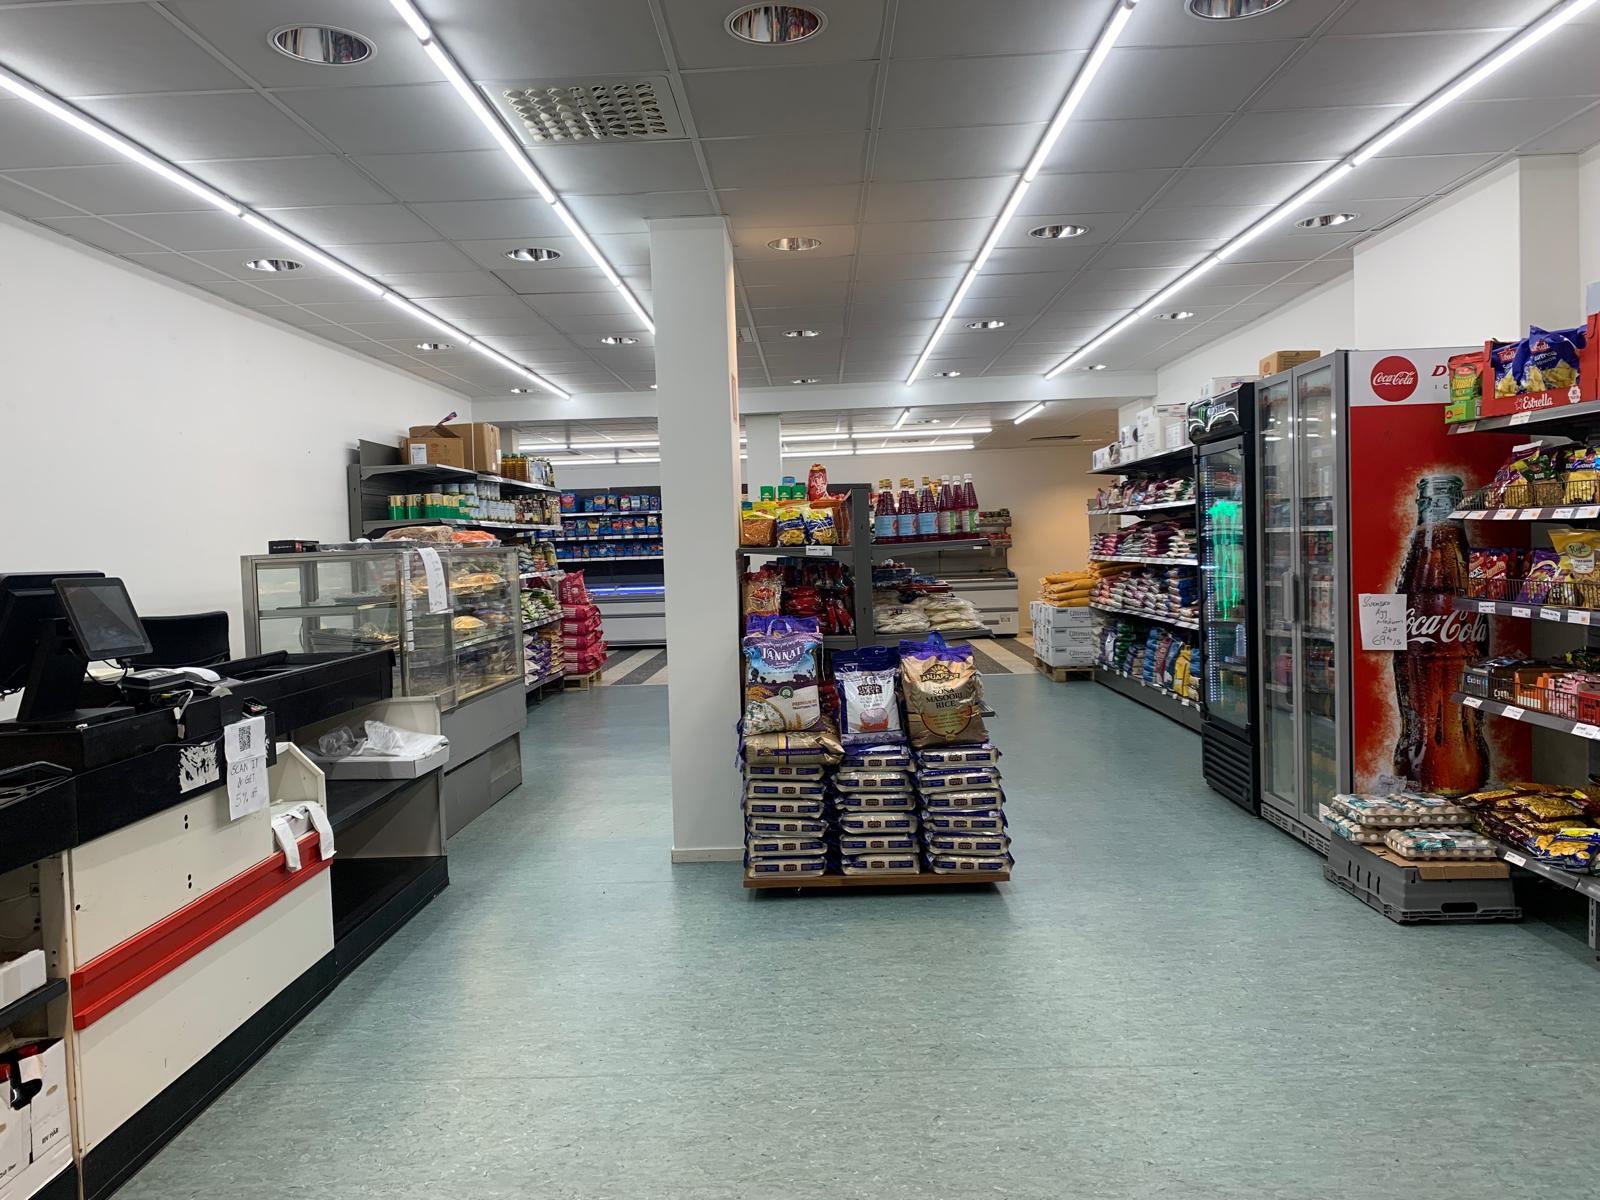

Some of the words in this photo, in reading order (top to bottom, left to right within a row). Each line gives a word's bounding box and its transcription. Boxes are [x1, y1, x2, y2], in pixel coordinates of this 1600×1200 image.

[1373, 371, 1416, 386] Coca-Cola
[1522, 393, 1553, 410] Estrella
[926, 692, 962, 703] MASOORI
[936, 701, 956, 709] RICE
[231, 763, 248, 775] SCAN
[251, 758, 258, 769] IT
[245, 773, 255, 785] GET
